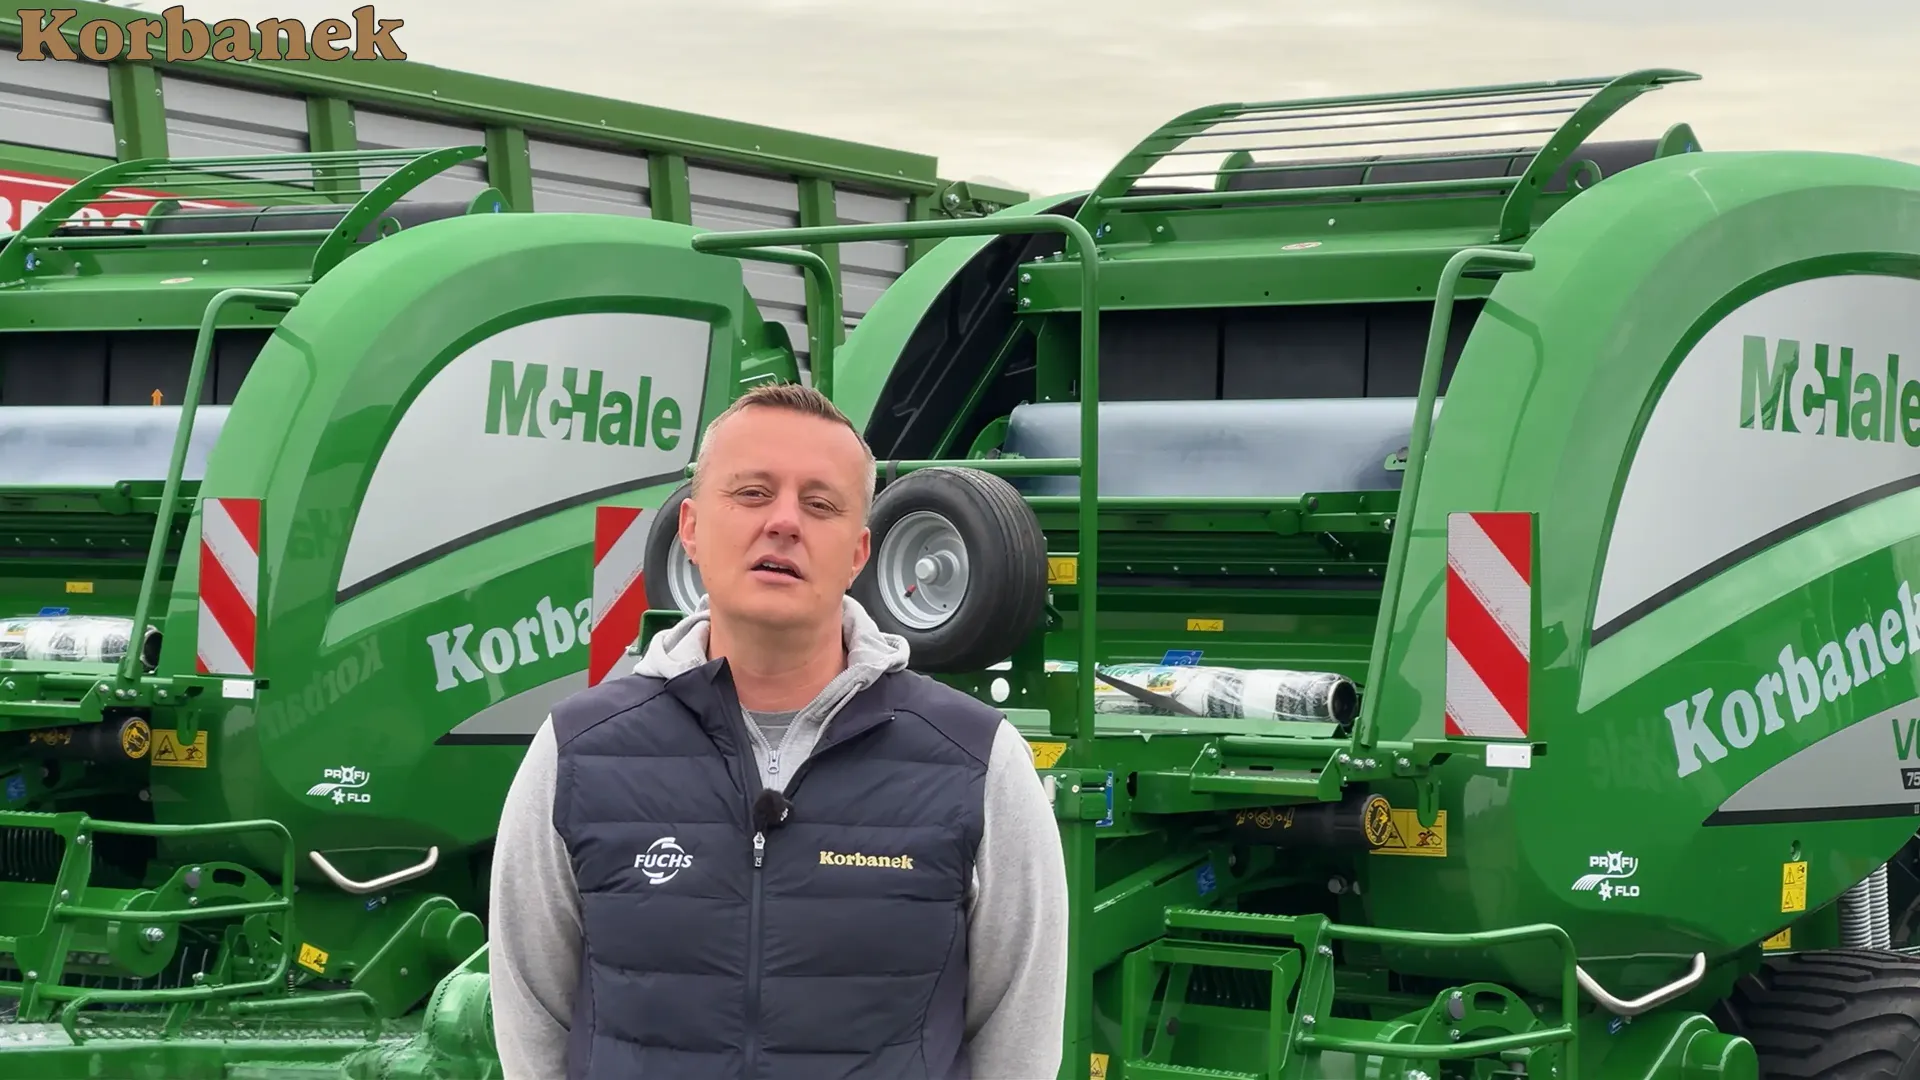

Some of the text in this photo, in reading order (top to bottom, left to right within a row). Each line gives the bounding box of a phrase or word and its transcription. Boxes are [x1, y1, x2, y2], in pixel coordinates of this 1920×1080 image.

[1739, 334, 1920, 448] McHale
[484, 359, 682, 451] McHale
[324, 765, 365, 784] PROFI
[347, 793, 371, 803] FLO
[633, 853, 694, 868] FUCHS
[819, 850, 914, 870] Korbanek
[1589, 850, 1634, 874] PROFI
[1615, 885, 1640, 897] FLO
